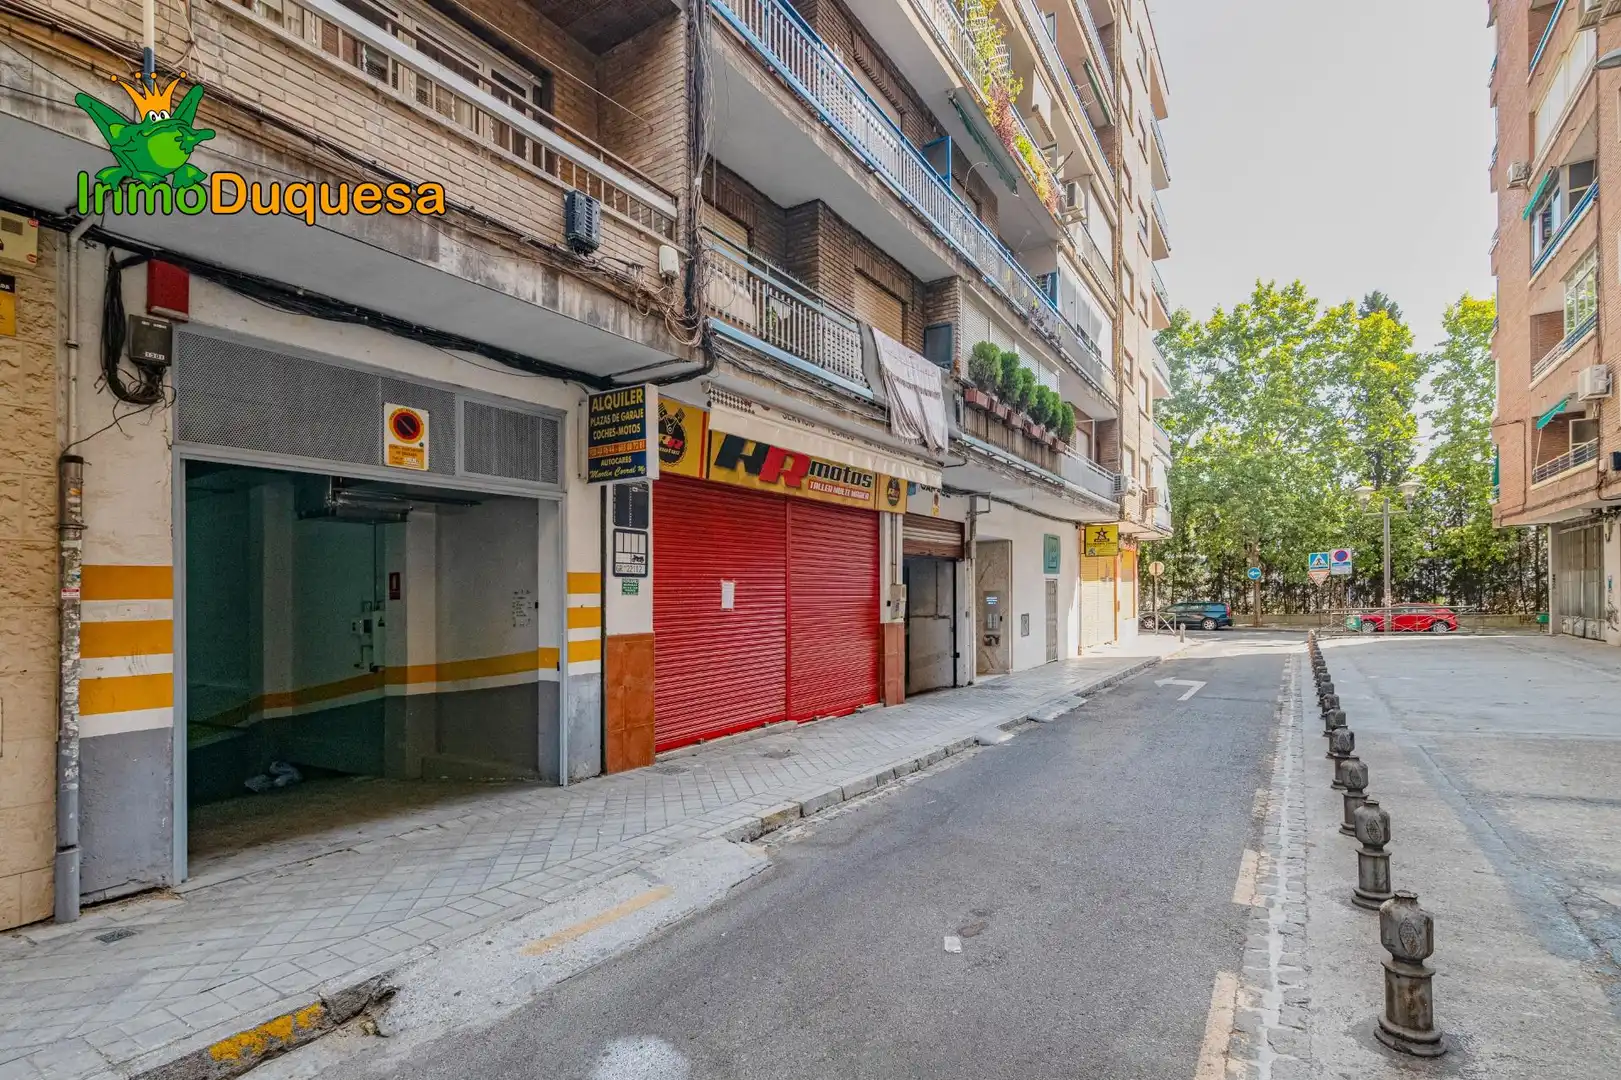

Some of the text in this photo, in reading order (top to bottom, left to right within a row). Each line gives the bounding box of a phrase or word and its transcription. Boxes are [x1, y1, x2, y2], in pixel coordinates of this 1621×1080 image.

[590, 408, 644, 427] PLAZAS DE GARAJE
[601, 456, 632, 466] AUTOCARES
[808, 459, 873, 488] motos
[810, 481, 833, 493] TALLER
